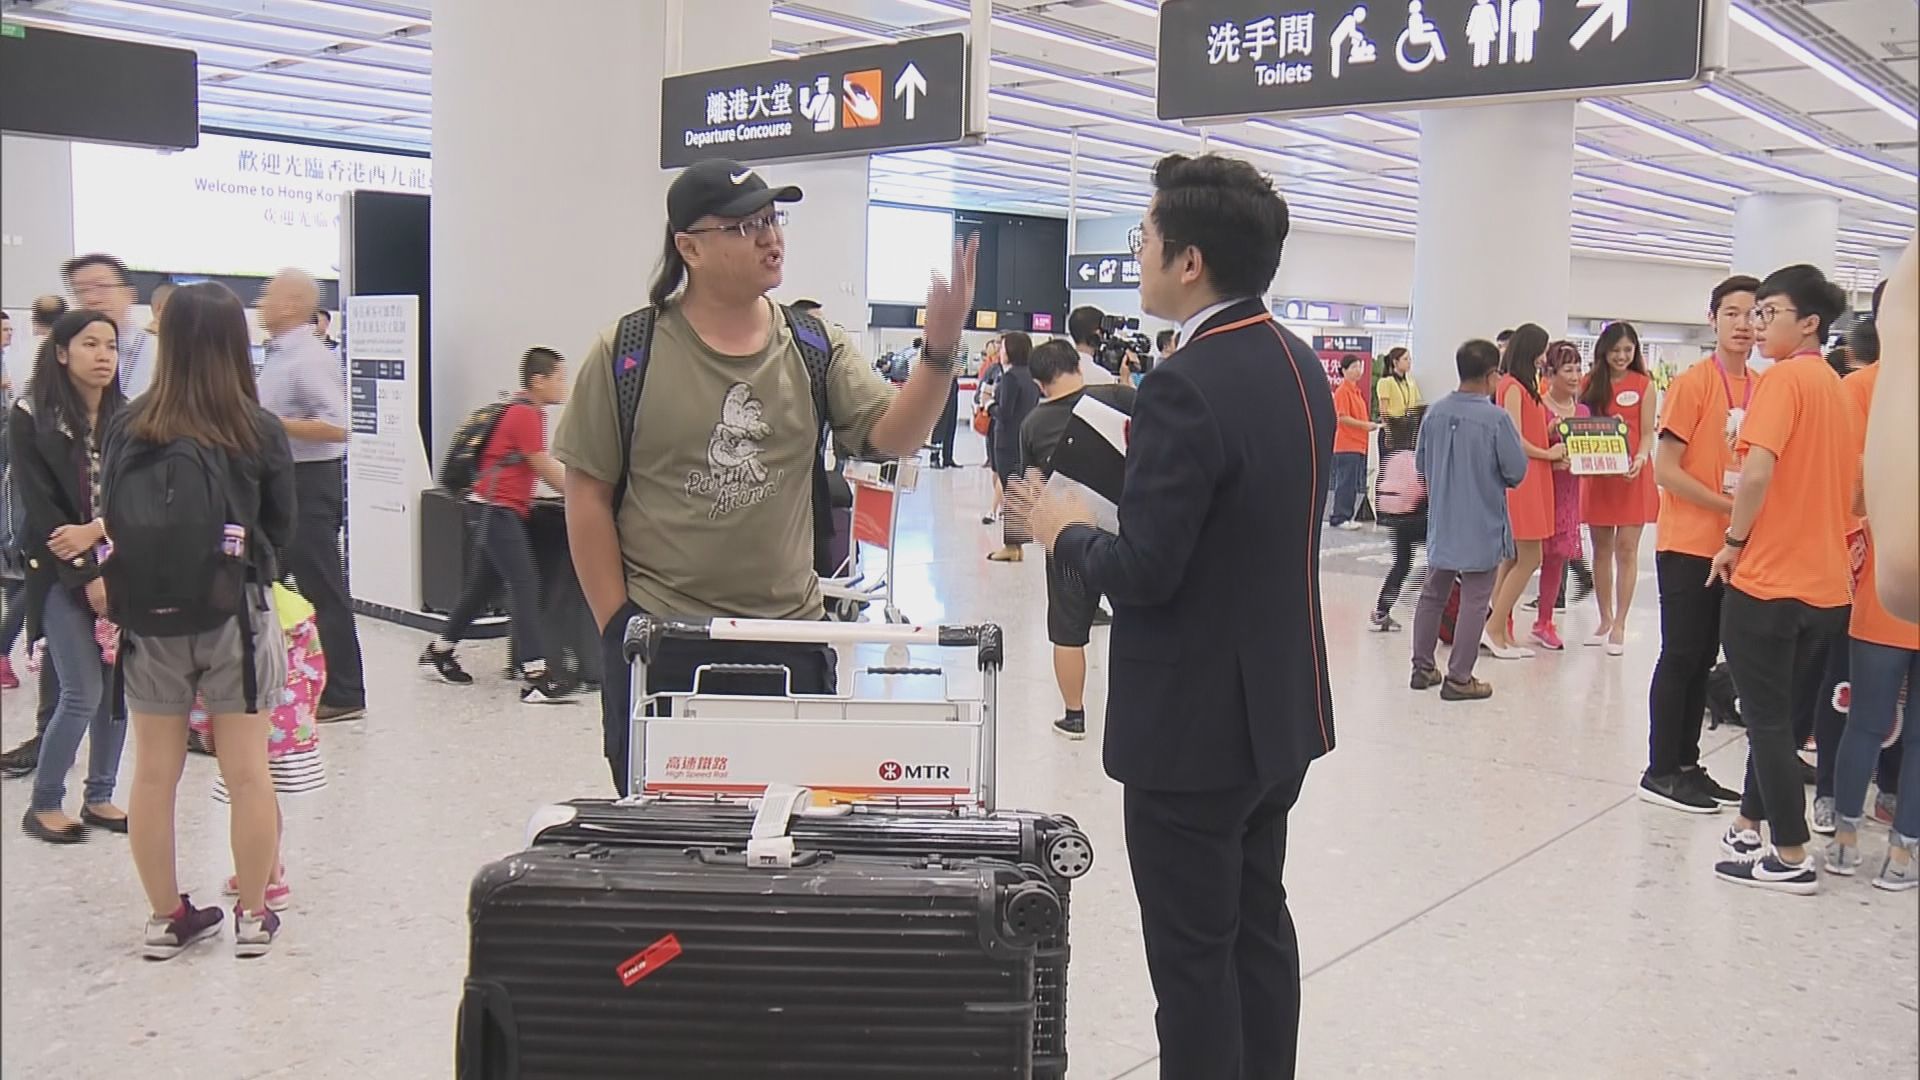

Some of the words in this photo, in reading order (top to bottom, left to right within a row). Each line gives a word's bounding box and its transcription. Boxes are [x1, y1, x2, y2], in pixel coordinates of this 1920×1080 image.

[1207, 12, 1314, 64] 洗手間
[1254, 64, 1313, 86] Toilets
[706, 82, 793, 125] 離港大堂
[685, 129, 736, 148] Departure
[736, 122, 792, 141] Concourse
[238, 150, 432, 189] 歡迎光臨香港西九龍
[194, 177, 257, 196] Welcome
[261, 186, 274, 197] to
[278, 186, 313, 203] Hong
[316, 190, 341, 203] Kon
[684, 466, 749, 496] Party
[665, 770, 685, 779] High
[686, 770, 712, 779] Speed
[904, 765, 950, 779] MTR
